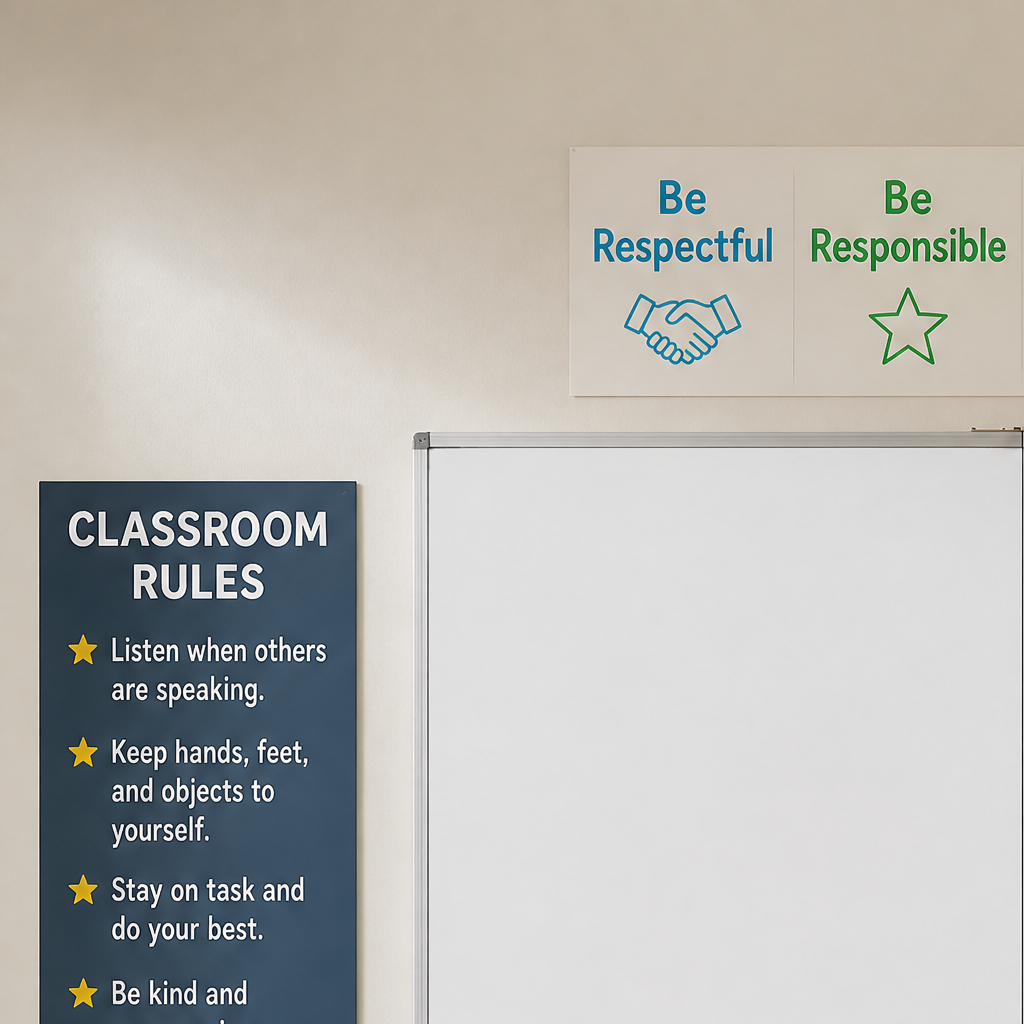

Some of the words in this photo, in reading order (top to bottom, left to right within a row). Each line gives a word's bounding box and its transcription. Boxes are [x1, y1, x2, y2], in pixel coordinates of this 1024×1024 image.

[659, 179, 706, 215] Be
[885, 180, 932, 215] Be
[593, 226, 773, 272] Respectful
[811, 227, 1006, 272] Responsible
[68, 510, 327, 548] CLASSROOM
[133, 563, 265, 600] RULES
[112, 636, 179, 662] Listen
[186, 636, 247, 662] when
[254, 636, 327, 663] others
[111, 682, 149, 701] are
[156, 675, 264, 708] speaking.
[112, 738, 167, 771] Keep
[175, 738, 249, 768] hands,
[256, 738, 309, 768] feet,
[111, 777, 153, 803] and
[161, 777, 244, 810] objects
[250, 779, 275, 803] to
[111, 815, 210, 849] yourself.
[111, 876, 163, 909] Stay
[170, 883, 198, 902] on
[206, 876, 256, 902] task
[262, 876, 304, 902] and
[111, 914, 141, 941] do
[148, 922, 200, 948] your
[208, 914, 263, 941] best.
[112, 980, 141, 1005] Be
[149, 979, 197, 1006] kind
[205, 979, 247, 1006] and
